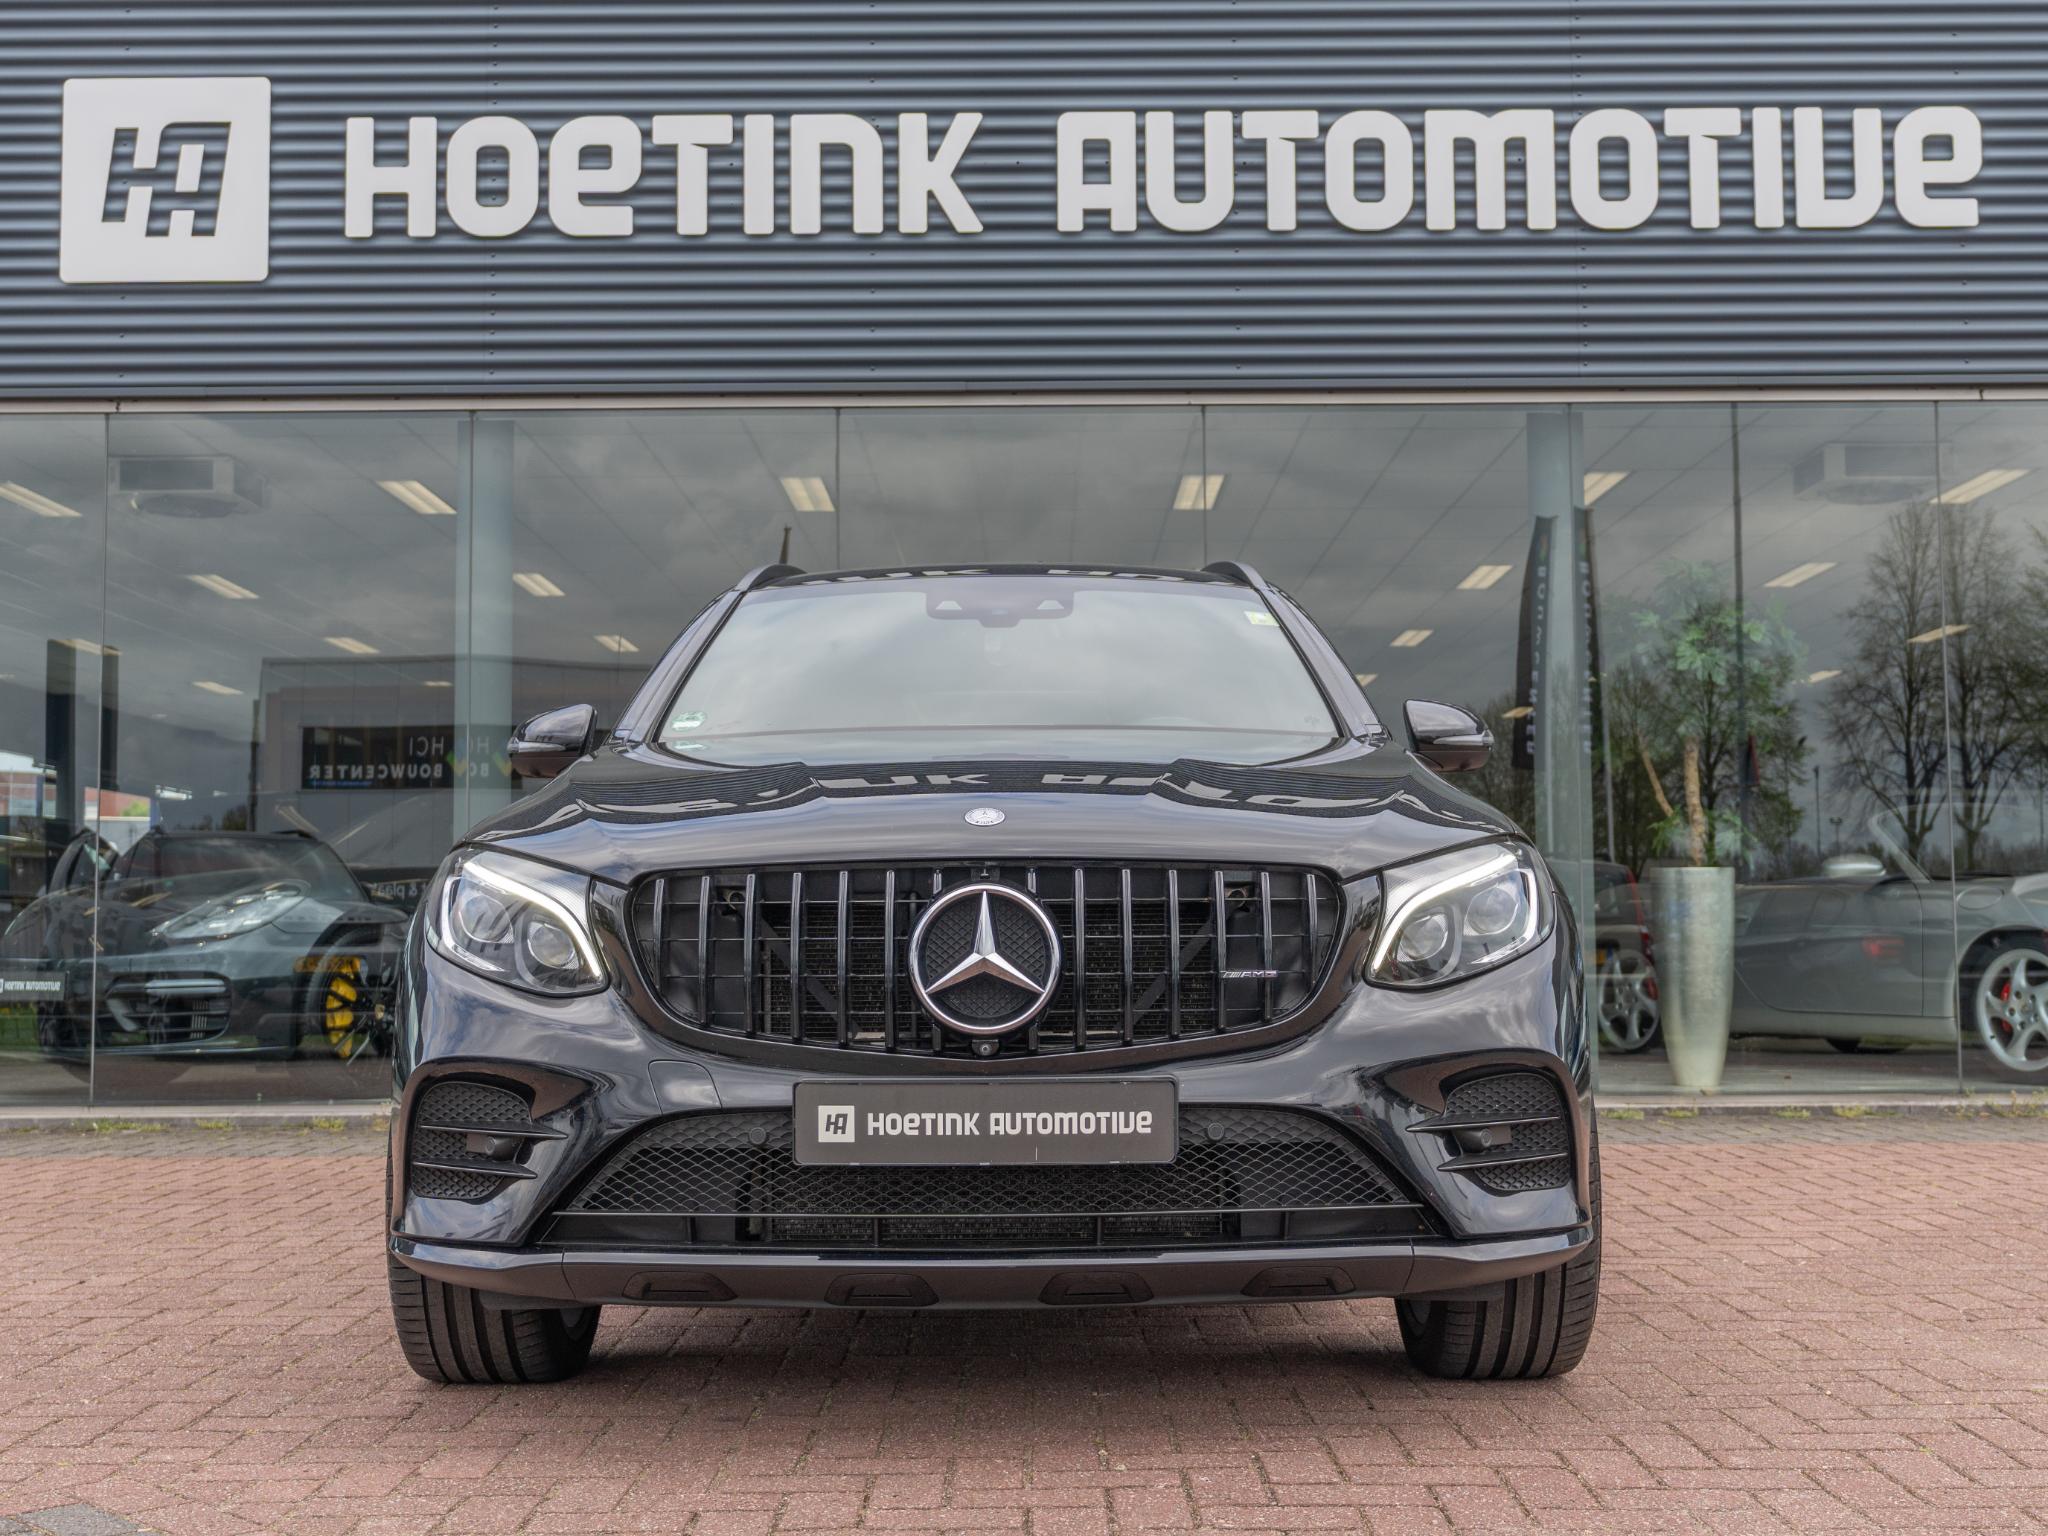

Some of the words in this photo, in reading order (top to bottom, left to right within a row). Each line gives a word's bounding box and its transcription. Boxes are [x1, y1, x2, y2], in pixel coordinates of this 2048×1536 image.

[344, 112, 983, 238] HOETINK
[1056, 105, 1983, 232] AUTOMOTIVE
[867, 1112, 980, 1136] HOETINK
[989, 1110, 1152, 1135] AUTOMOTIVE
